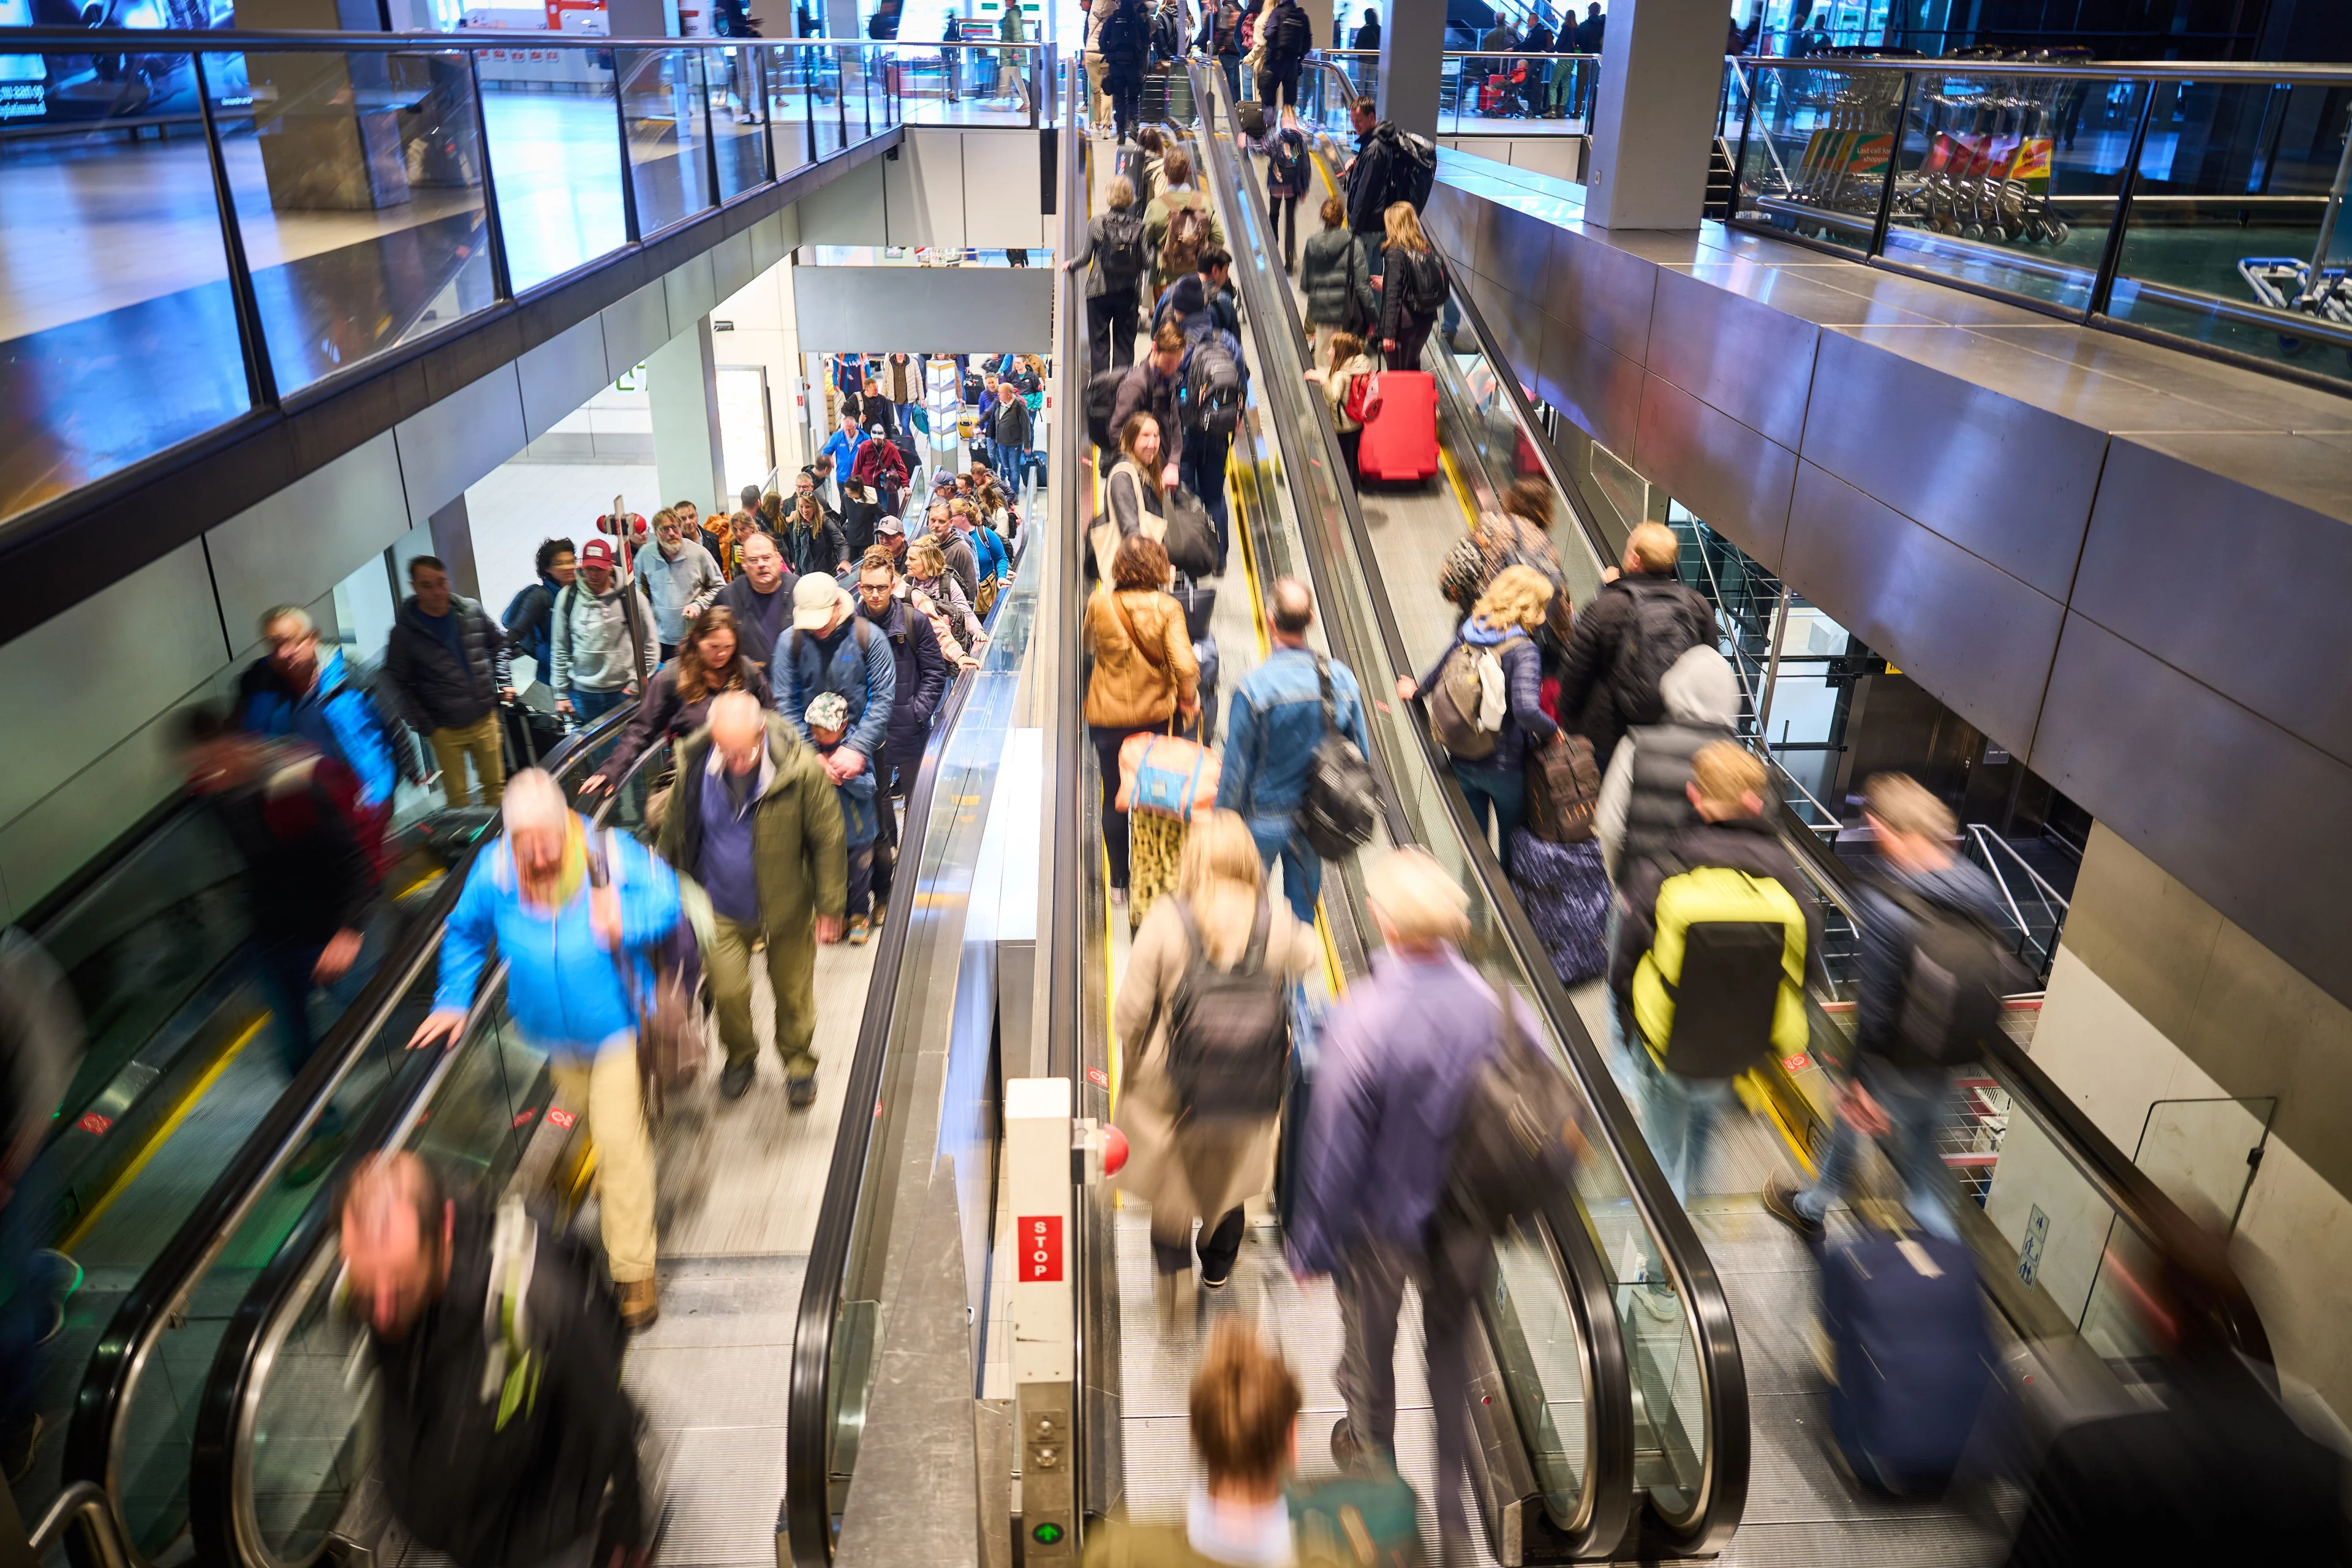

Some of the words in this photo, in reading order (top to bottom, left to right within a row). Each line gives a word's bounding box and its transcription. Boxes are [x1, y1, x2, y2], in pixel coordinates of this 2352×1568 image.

[1863, 155, 1888, 164] shoppin
[1785, 1060, 1795, 1069] STOP
[1033, 1221, 1048, 1277] STOP
